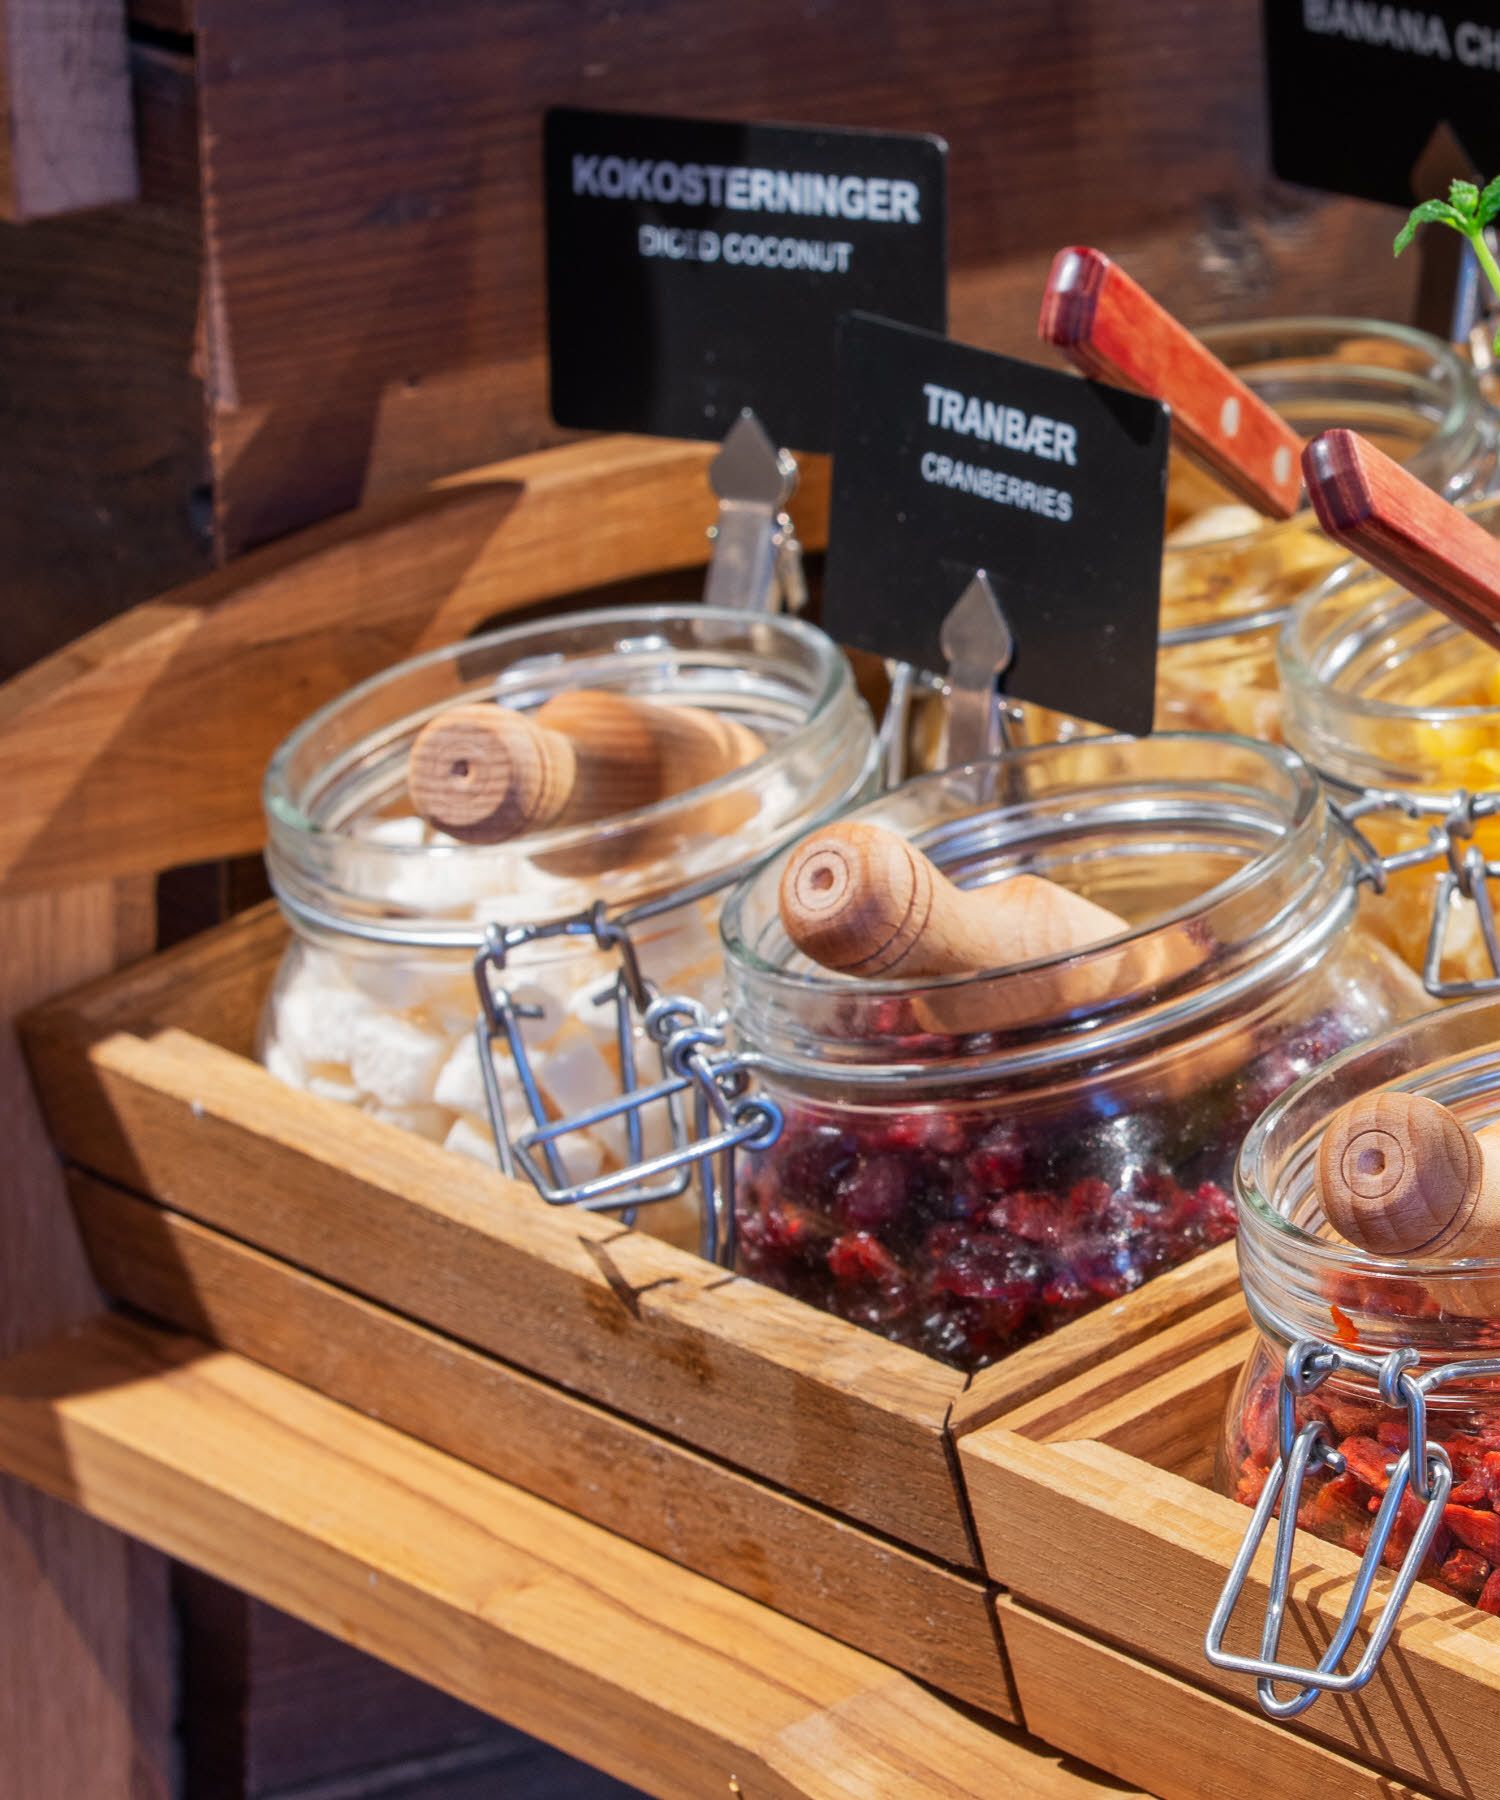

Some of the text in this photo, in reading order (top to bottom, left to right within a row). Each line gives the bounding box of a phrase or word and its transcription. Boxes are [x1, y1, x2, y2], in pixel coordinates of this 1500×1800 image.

[1303, 0, 1450, 61] BANANA
[571, 153, 922, 225] KOKOSTERNINGER
[638, 224, 854, 274] DICED COCONUT
[923, 382, 1077, 467] TRANBÆR
[920, 451, 1073, 523] CRANBERRIES
